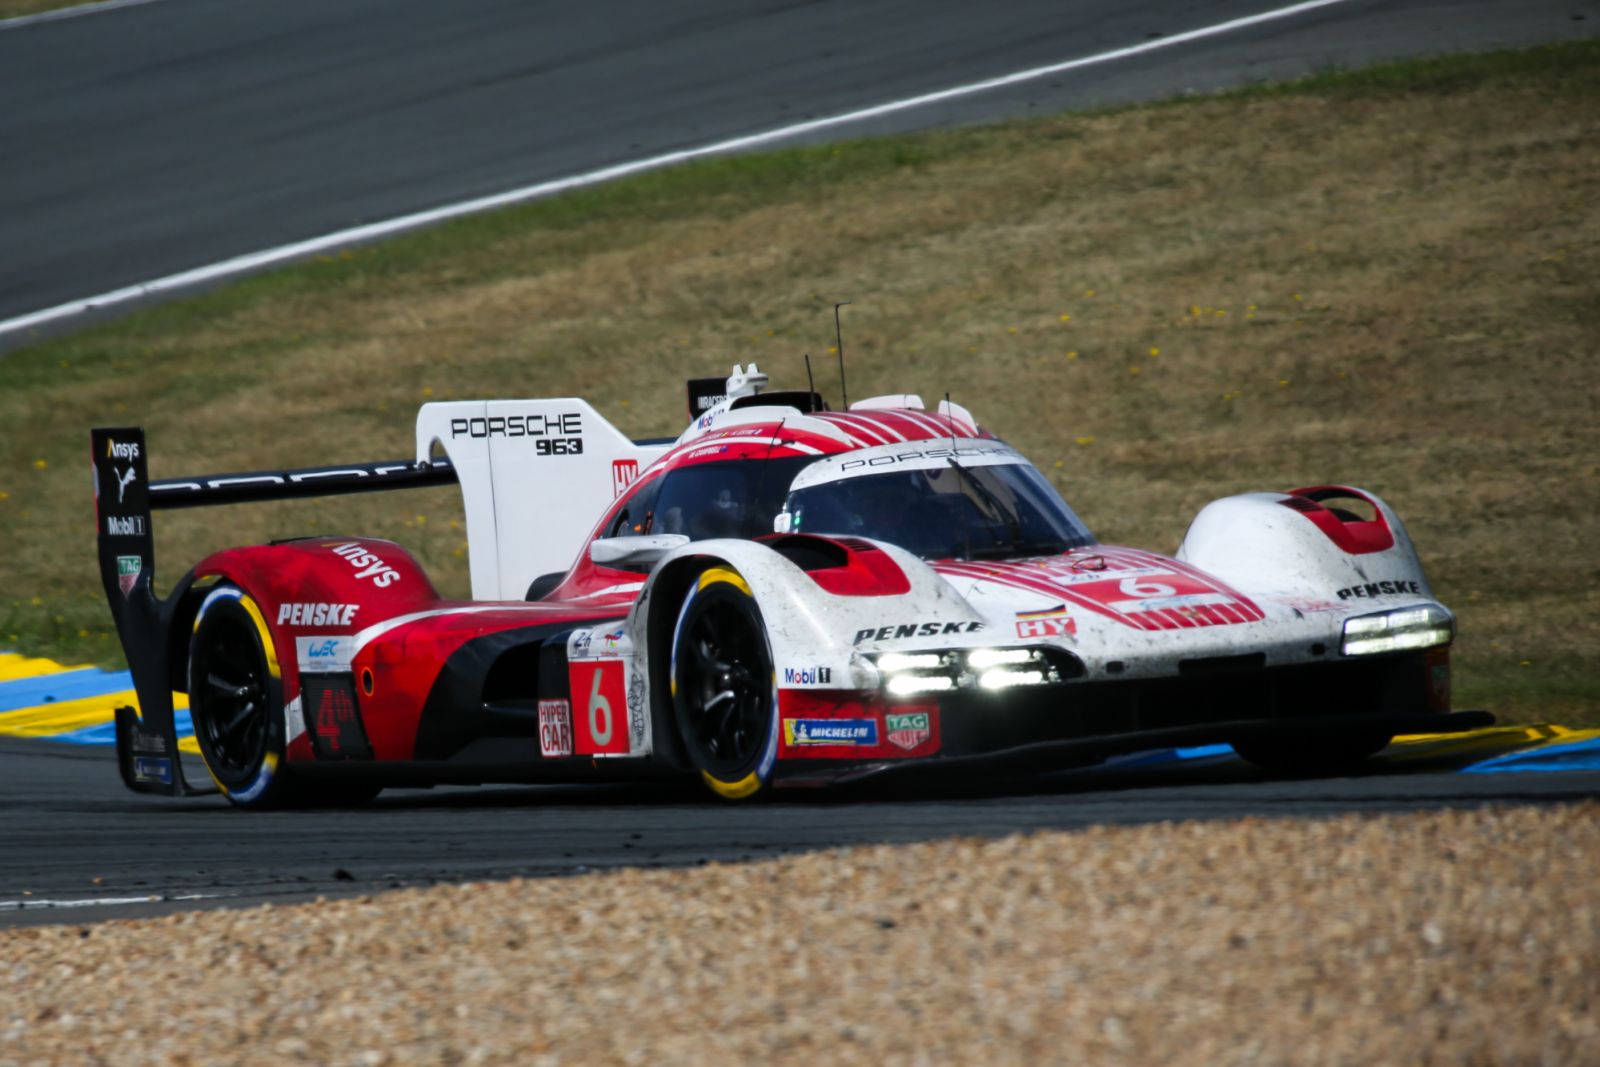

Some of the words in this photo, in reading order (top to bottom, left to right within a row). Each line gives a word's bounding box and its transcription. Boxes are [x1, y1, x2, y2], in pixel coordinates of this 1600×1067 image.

[451, 413, 582, 439] PORSCHE
[107, 439, 139, 462] Ansys
[536, 438, 583, 456] 963
[108, 517, 134, 535] Mobil
[121, 559, 139, 573] TAG
[1119, 578, 1177, 598] 6
[1336, 581, 1420, 600] PENSKE
[277, 603, 360, 626] PENSKE
[853, 622, 985, 646] PENSKE
[1019, 620, 1070, 637] HY
[309, 639, 339, 657] WEC
[785, 668, 815, 684] Mobil
[540, 705, 568, 723] HYPER
[588, 668, 613, 746] 6
[890, 715, 925, 729] TAG
[542, 723, 570, 752] CAR
[811, 727, 868, 738] MICHELIN
